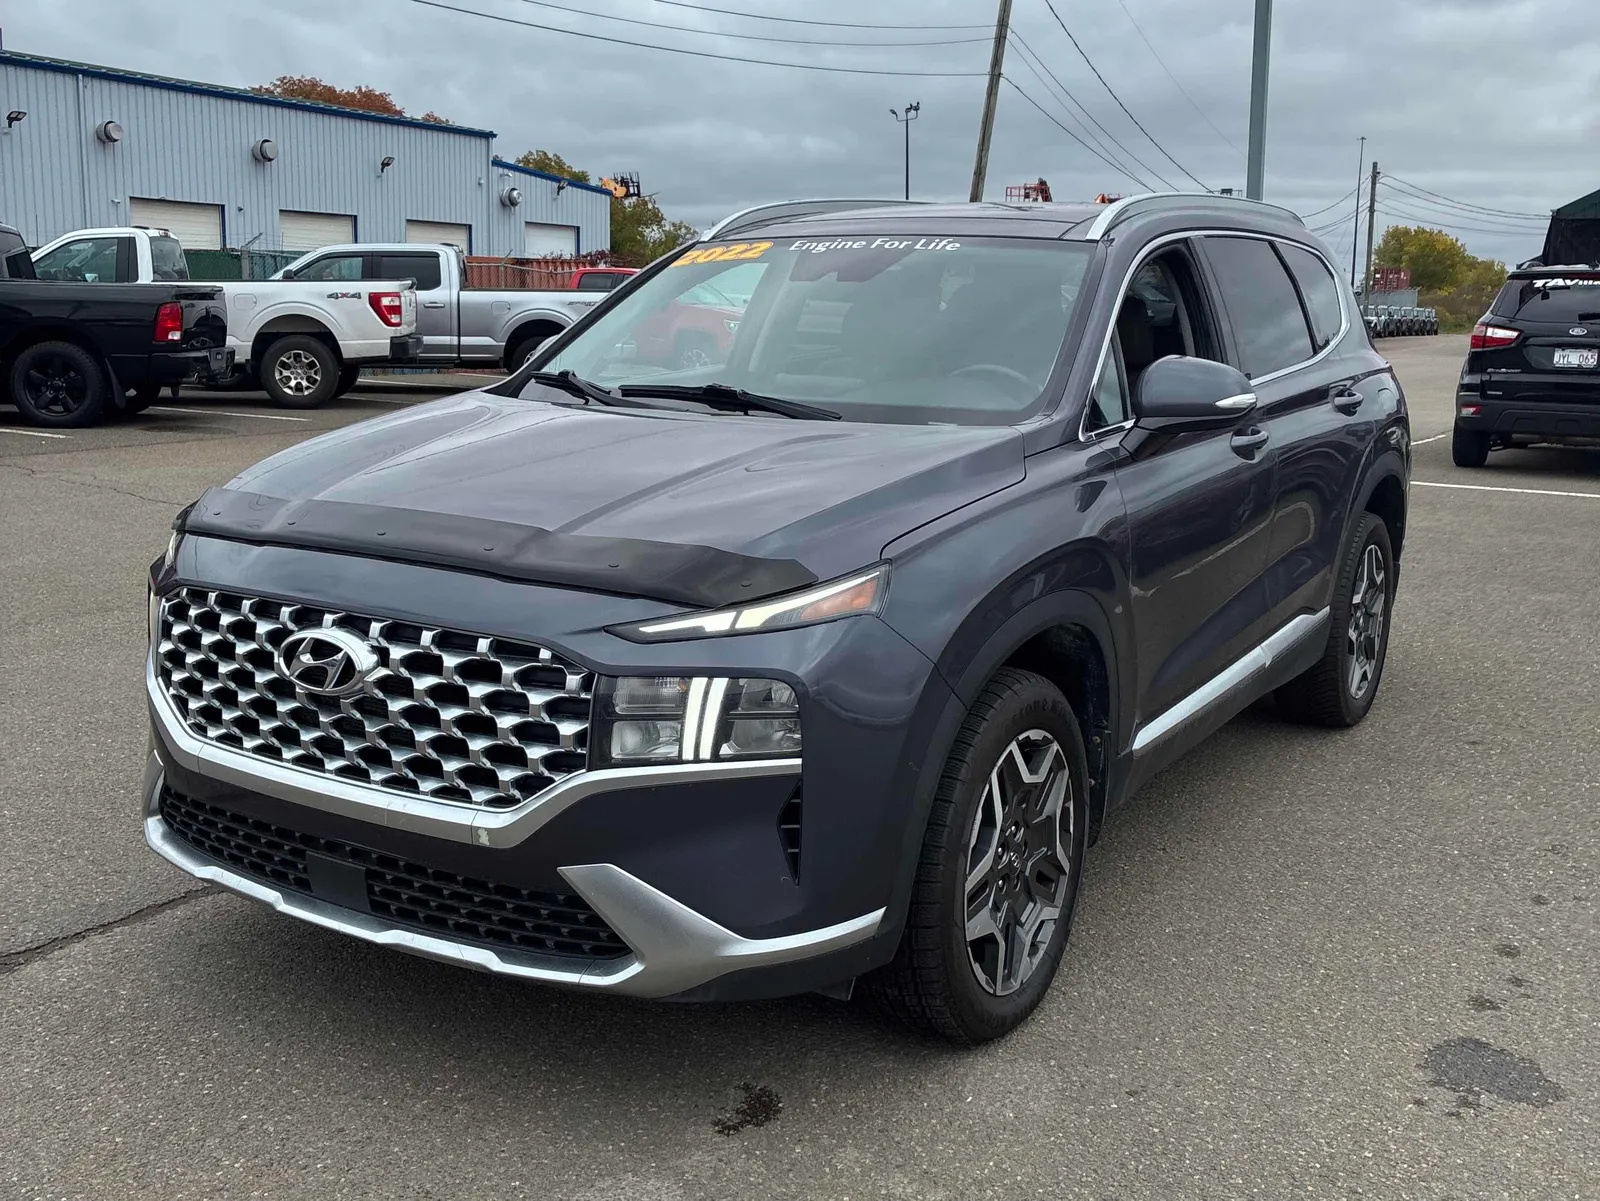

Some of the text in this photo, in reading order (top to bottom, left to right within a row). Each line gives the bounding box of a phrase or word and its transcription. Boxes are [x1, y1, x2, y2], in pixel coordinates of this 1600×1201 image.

[789, 238, 961, 253] Engine For Life
[671, 240, 775, 268] 2022
[1555, 353, 1596, 364] JYL 065
